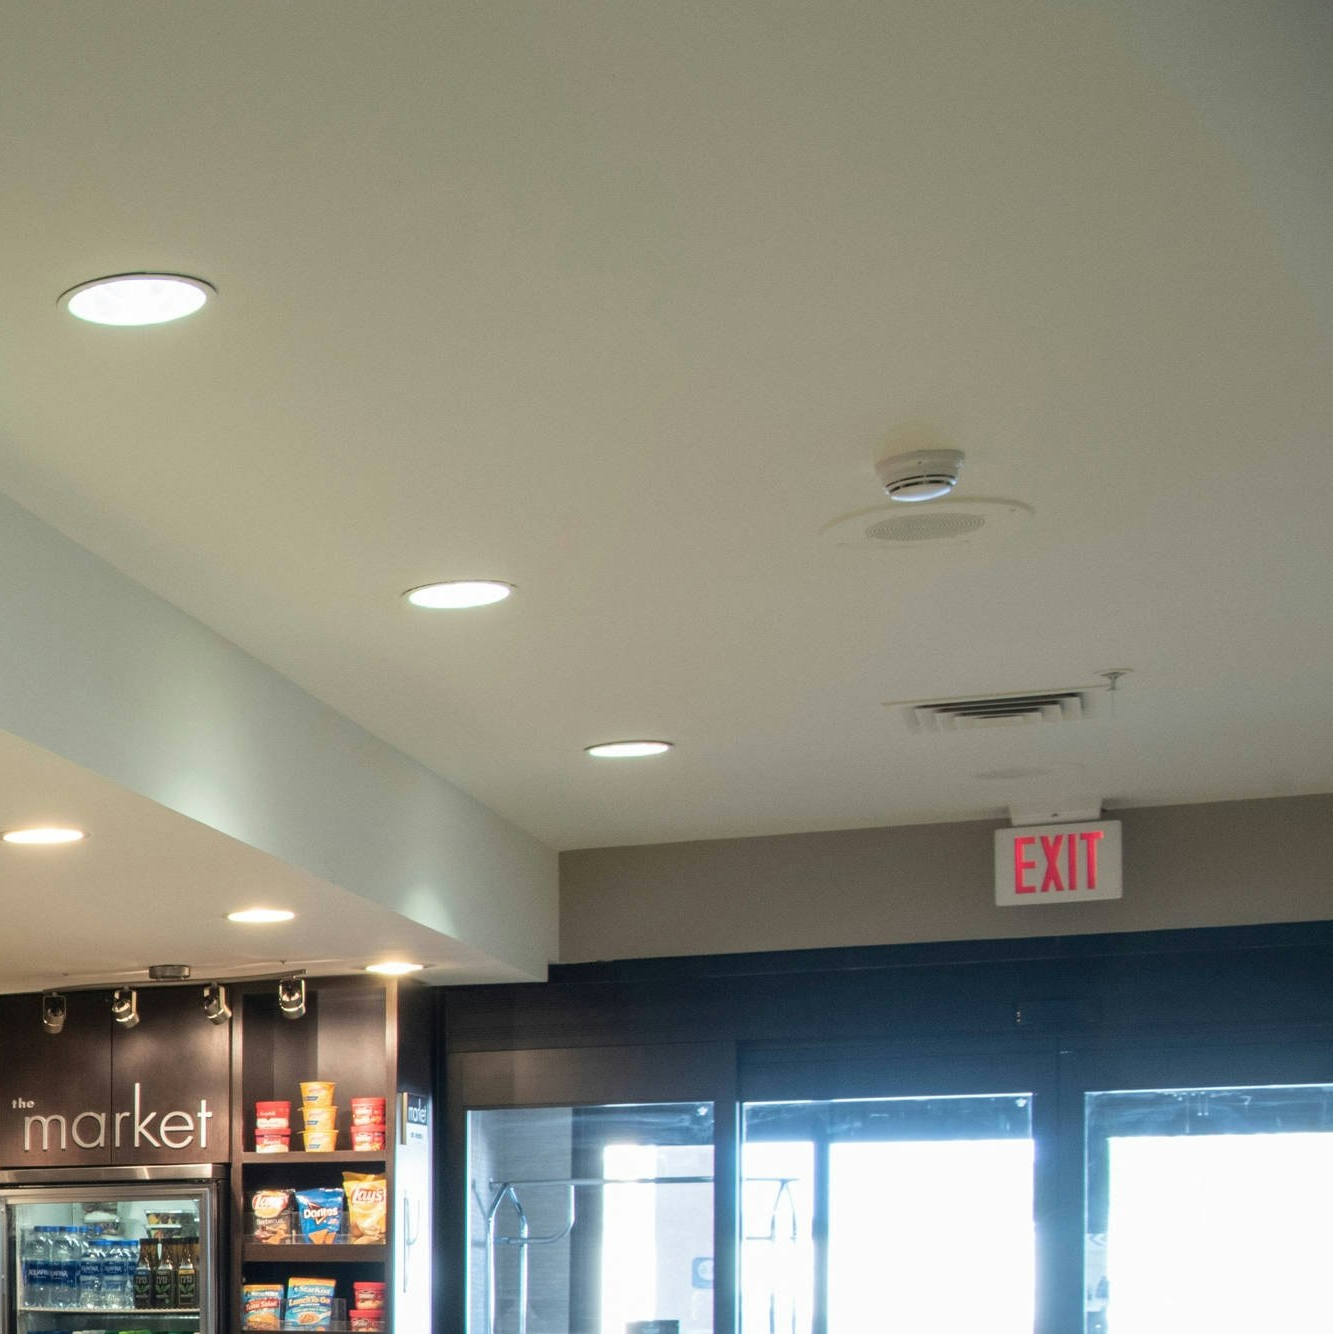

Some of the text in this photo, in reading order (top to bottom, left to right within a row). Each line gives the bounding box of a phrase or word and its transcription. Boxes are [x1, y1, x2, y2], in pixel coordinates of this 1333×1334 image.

[1014, 830, 1104, 895] EXIT
[12, 1097, 35, 1109] the
[24, 1082, 213, 1151] market
[303, 1207, 339, 1219] Doritos
